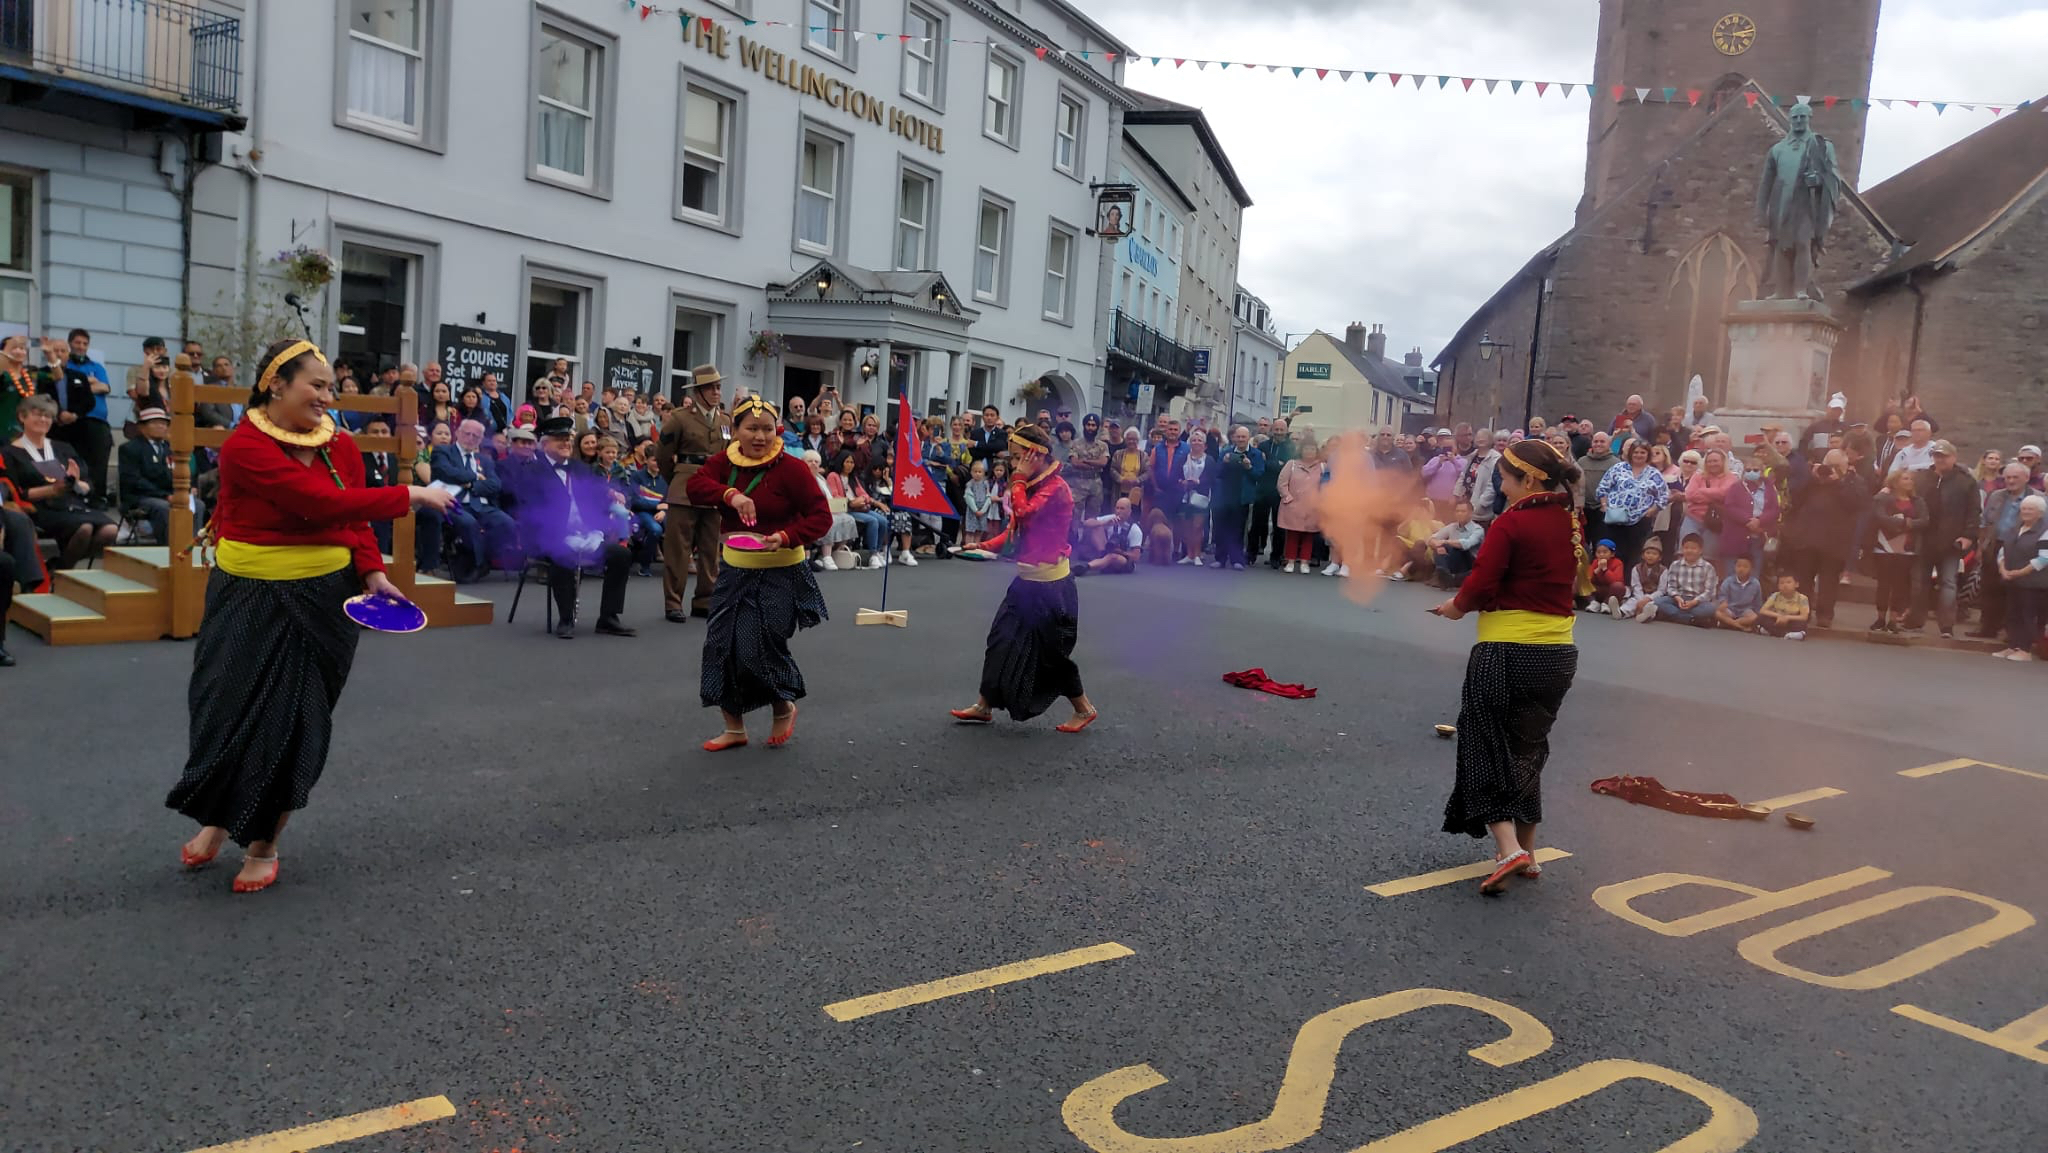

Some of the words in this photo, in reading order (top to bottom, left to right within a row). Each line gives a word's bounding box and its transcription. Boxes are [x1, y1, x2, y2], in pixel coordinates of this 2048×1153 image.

[678, 7, 730, 59] THE
[739, 35, 885, 126] WELLINGTON
[889, 106, 945, 154] HOTEL
[446, 346, 456, 362] 2
[460, 348, 509, 369] COURSE
[446, 362, 466, 378] Set
[471, 366, 504, 382] Mu
[1299, 365, 1329, 373] HARLEY
